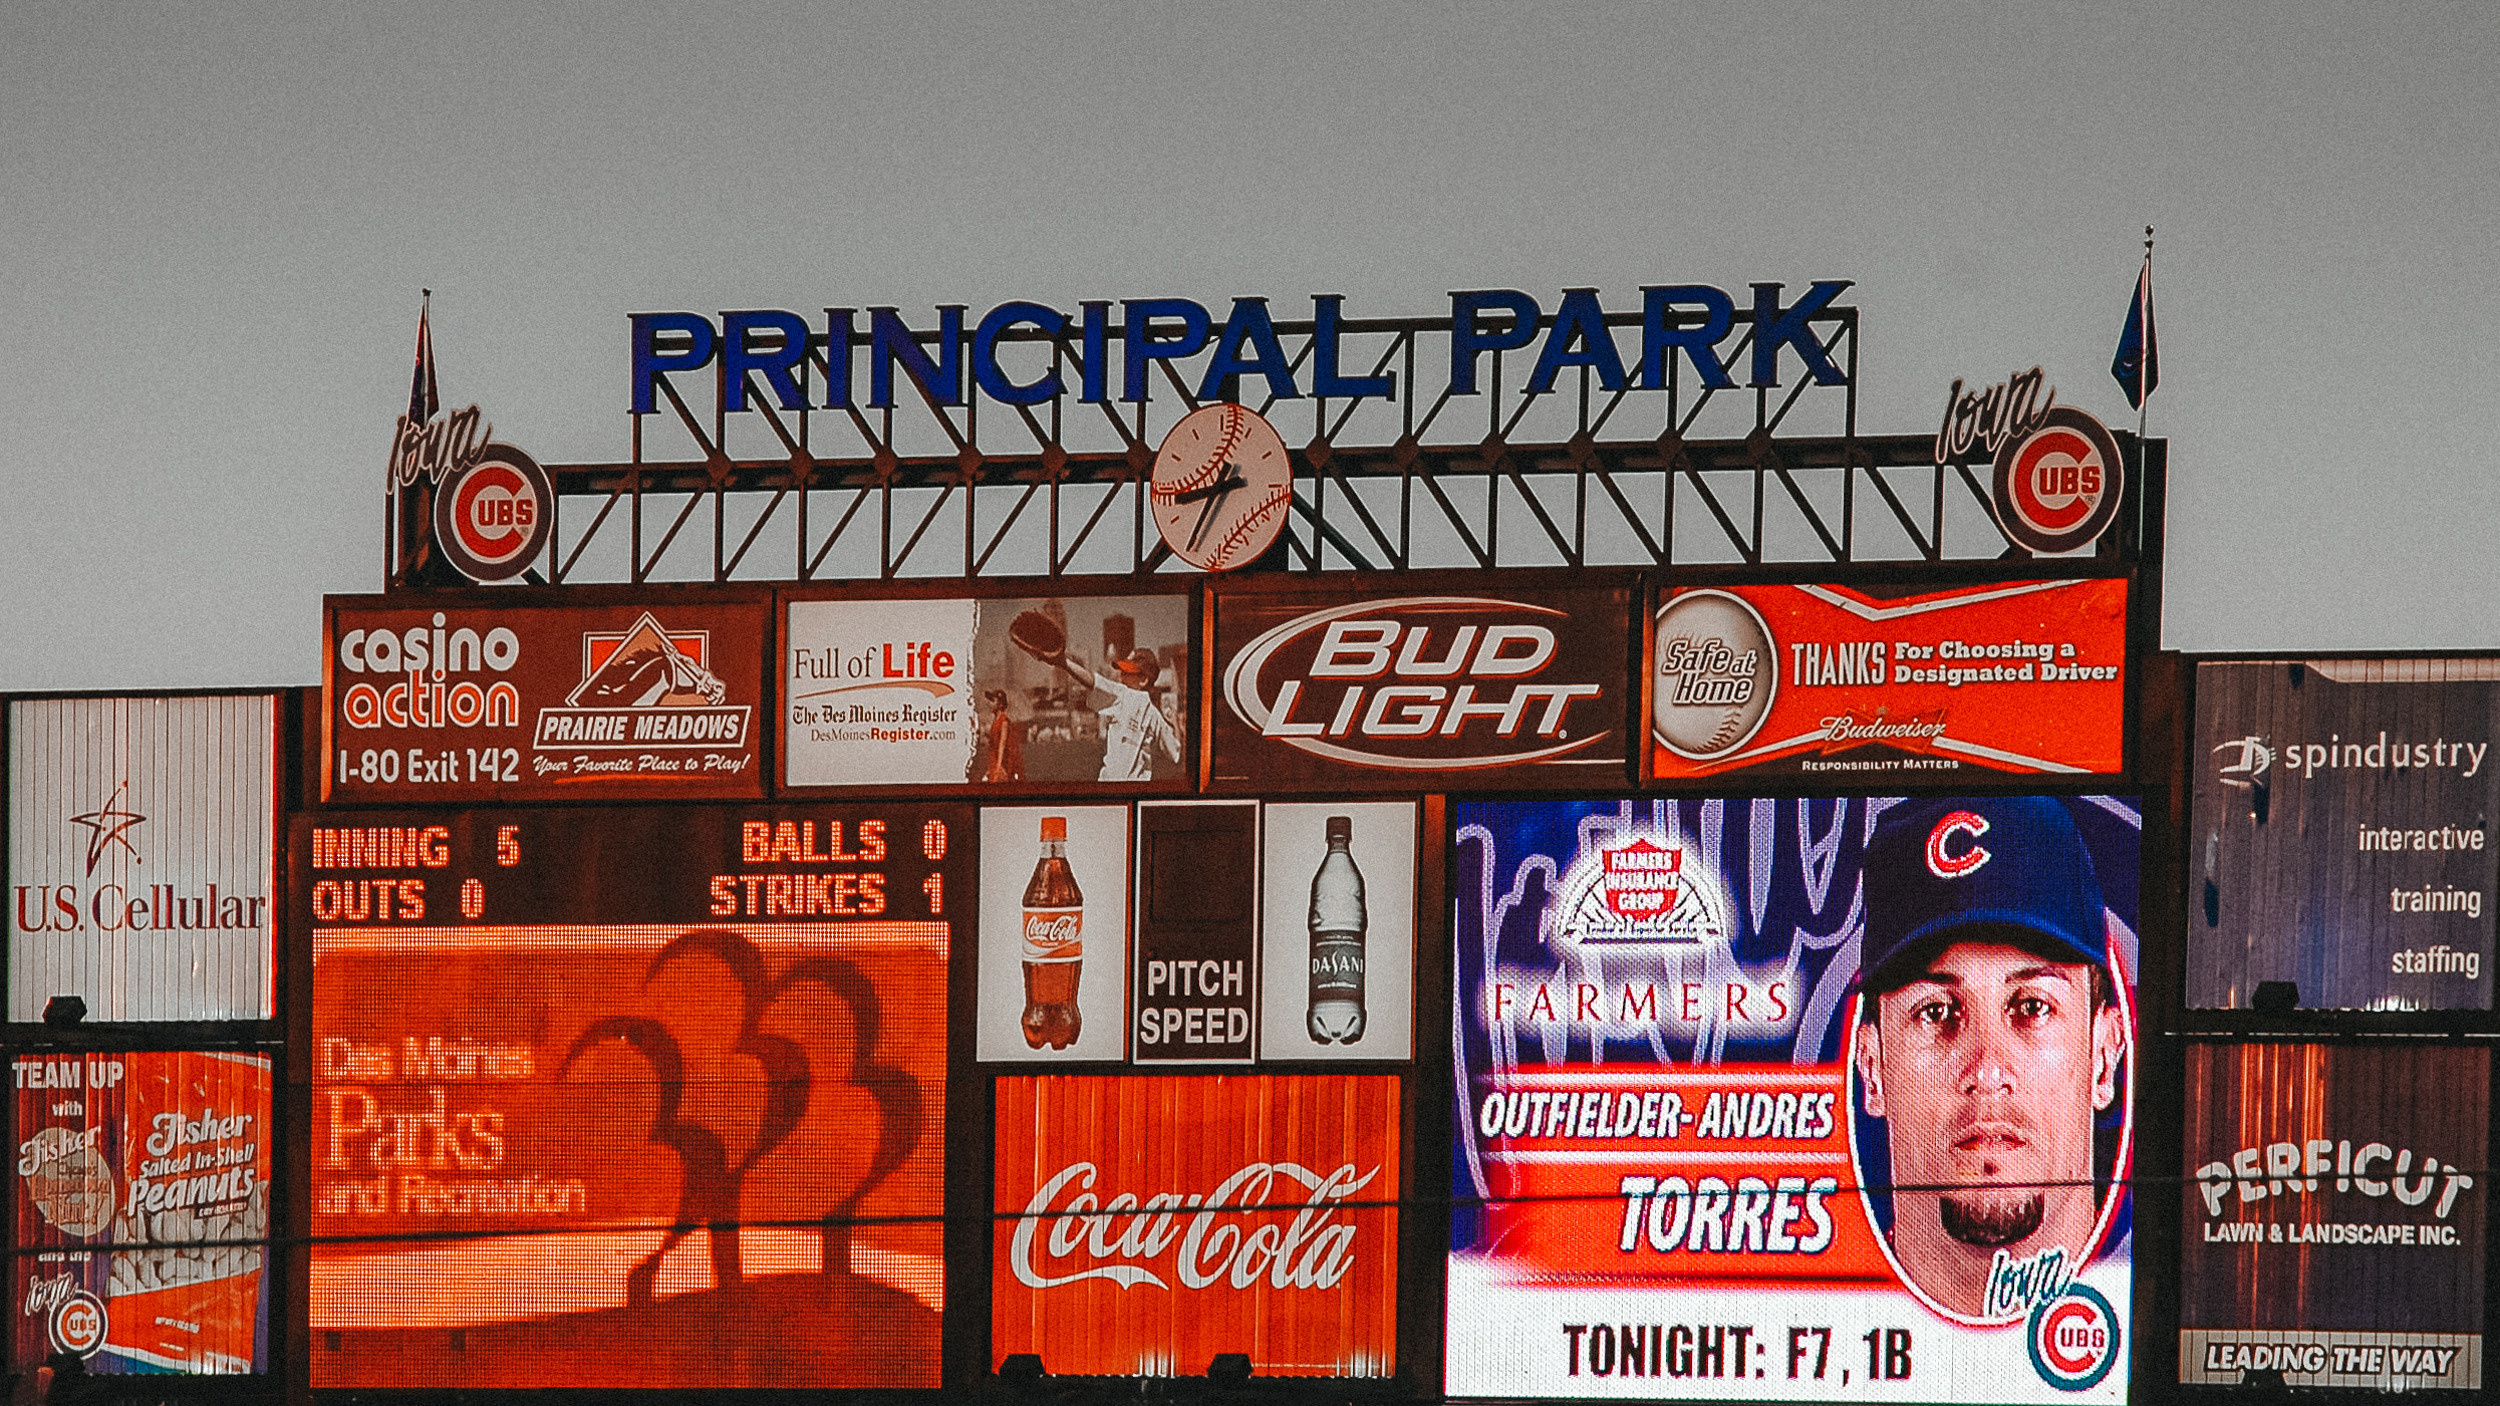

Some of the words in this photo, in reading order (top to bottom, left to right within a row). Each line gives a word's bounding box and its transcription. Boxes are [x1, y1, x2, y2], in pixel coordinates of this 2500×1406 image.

[627, 293, 1398, 415] PRINCIPAL
[1447, 280, 1856, 396] PARK
[1936, 365, 2057, 465] Iowa
[387, 404, 493, 495] Iowa
[2013, 431, 2101, 530] CUBS
[455, 466, 534, 559] CUBS
[340, 611, 520, 674] casino
[794, 647, 839, 679] Full
[847, 645, 877, 678] of
[882, 641, 956, 679] Life
[1309, 620, 1557, 678] BUD
[1662, 639, 1731, 674] Safe
[1729, 649, 1757, 676] at
[1791, 641, 1886, 686] THANKS
[1894, 641, 1934, 660] For
[1940, 640, 2055, 665] Choosing
[2059, 642, 2075, 658] a
[1672, 670, 1753, 704] Home
[1894, 664, 2034, 686] Designated
[2041, 662, 2118, 682] Driver
[343, 668, 520, 729] action
[792, 704, 818, 727] The
[822, 704, 846, 724] Des
[848, 704, 899, 724] Moines
[901, 703, 958, 727] Register
[1262, 680, 1601, 738] LIGHT
[542, 715, 628, 741] PRAIRIE
[633, 714, 740, 740] MEADOWS
[810, 726, 956, 744] DesMoinesRegister.com
[1820, 712, 1946, 742] Budweiser
[339, 749, 399, 784] I-80
[408, 749, 459, 783] Exit
[466, 747, 520, 783] 142
[533, 755, 568, 776] Your
[572, 754, 633, 774] Favorite
[637, 754, 680, 772] Place
[684, 757, 698, 771] to
[703, 753, 751, 774] Play!
[1802, 759, 1900, 771] RESPONSIBILITY
[1903, 758, 1960, 770] MATTERS
[2285, 730, 2488, 779] spindustry
[312, 826, 450, 868] INNING
[497, 825, 521, 867] 5
[742, 819, 887, 862] BALLS
[922, 819, 948, 861] 0
[1925, 810, 1991, 878] C
[2358, 823, 2485, 851] interactive
[1605, 870, 1680, 891] INSURANCE
[1611, 851, 1673, 870] FARMERS
[13, 883, 85, 932] U.S.
[91, 882, 266, 931] Cellular
[312, 879, 426, 921] OUTS
[460, 878, 486, 920] 0
[710, 872, 887, 916] STRIKES
[922, 872, 945, 915] 1
[1617, 891, 1666, 911] GROUP
[2391, 883, 2482, 918] training
[1147, 959, 1243, 997] PITCH
[1312, 950, 1364, 976] DASANI
[2391, 945, 2480, 979] staffing
[1493, 980, 1789, 1023] FARMERS
[1139, 1006, 1249, 1045] SPEED
[12, 1061, 80, 1089] TEAM
[89, 1060, 124, 1089] UP
[52, 1100, 83, 1117] with
[326, 1085, 504, 1170] Parks
[1480, 1090, 1693, 1139] OUTFIELDER-
[1696, 1090, 1836, 1139] ANDRES
[19, 1125, 102, 1177] Fisher
[145, 1107, 254, 1157] Fisher
[127, 1165, 255, 1217] Peanuts
[2195, 1139, 2473, 1218] PERFICUT
[1010, 1161, 1381, 1291] Coca-Cola
[1618, 1174, 1839, 1254] TORRES
[2203, 1222, 2264, 1243] LAWN
[2267, 1223, 2283, 1243] &
[2288, 1222, 2415, 1245] LANDSCAPE
[2419, 1225, 2462, 1246] INC.
[1985, 1248, 2075, 1317] Iowa
[1562, 1322, 1766, 1380] TONIGHT:
[1861, 1326, 1913, 1380] 1B
[2206, 1345, 2325, 1371] LEADING
[2333, 1346, 2383, 1372] THE
[2390, 1348, 2454, 1374] WAY
